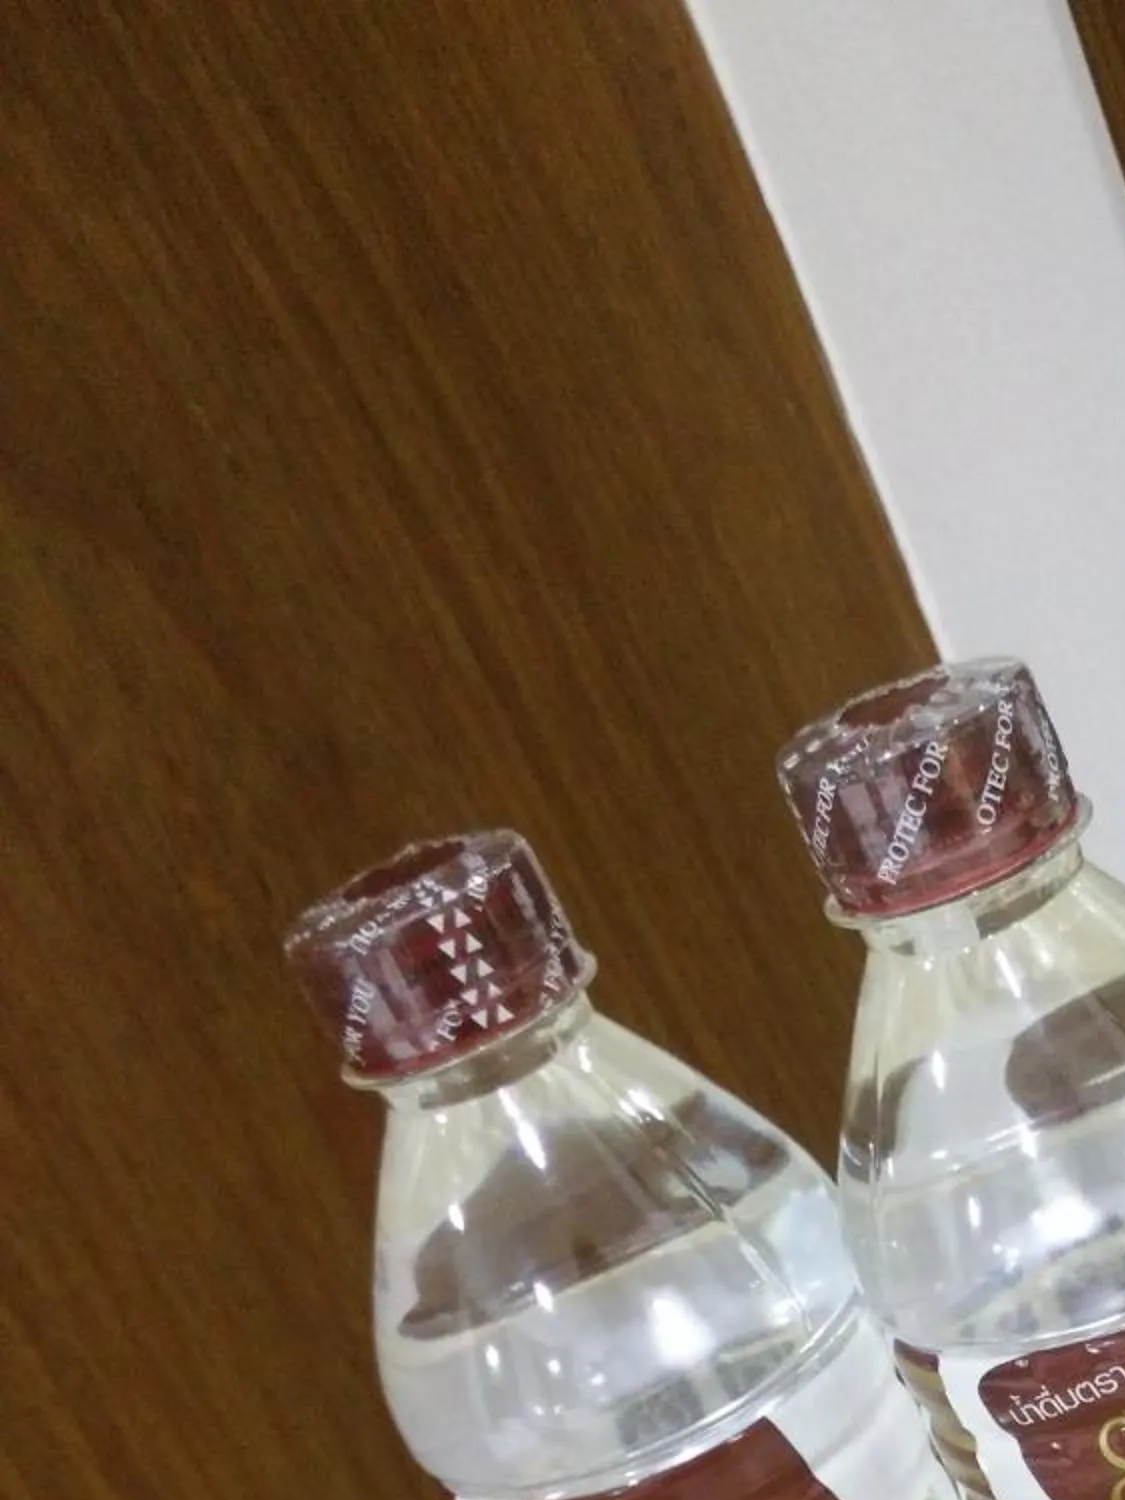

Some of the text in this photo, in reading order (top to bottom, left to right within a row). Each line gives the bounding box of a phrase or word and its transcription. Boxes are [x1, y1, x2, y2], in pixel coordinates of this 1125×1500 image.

[995, 699, 1014, 752] FOR
[877, 741, 949, 886] PROTEC FOR
